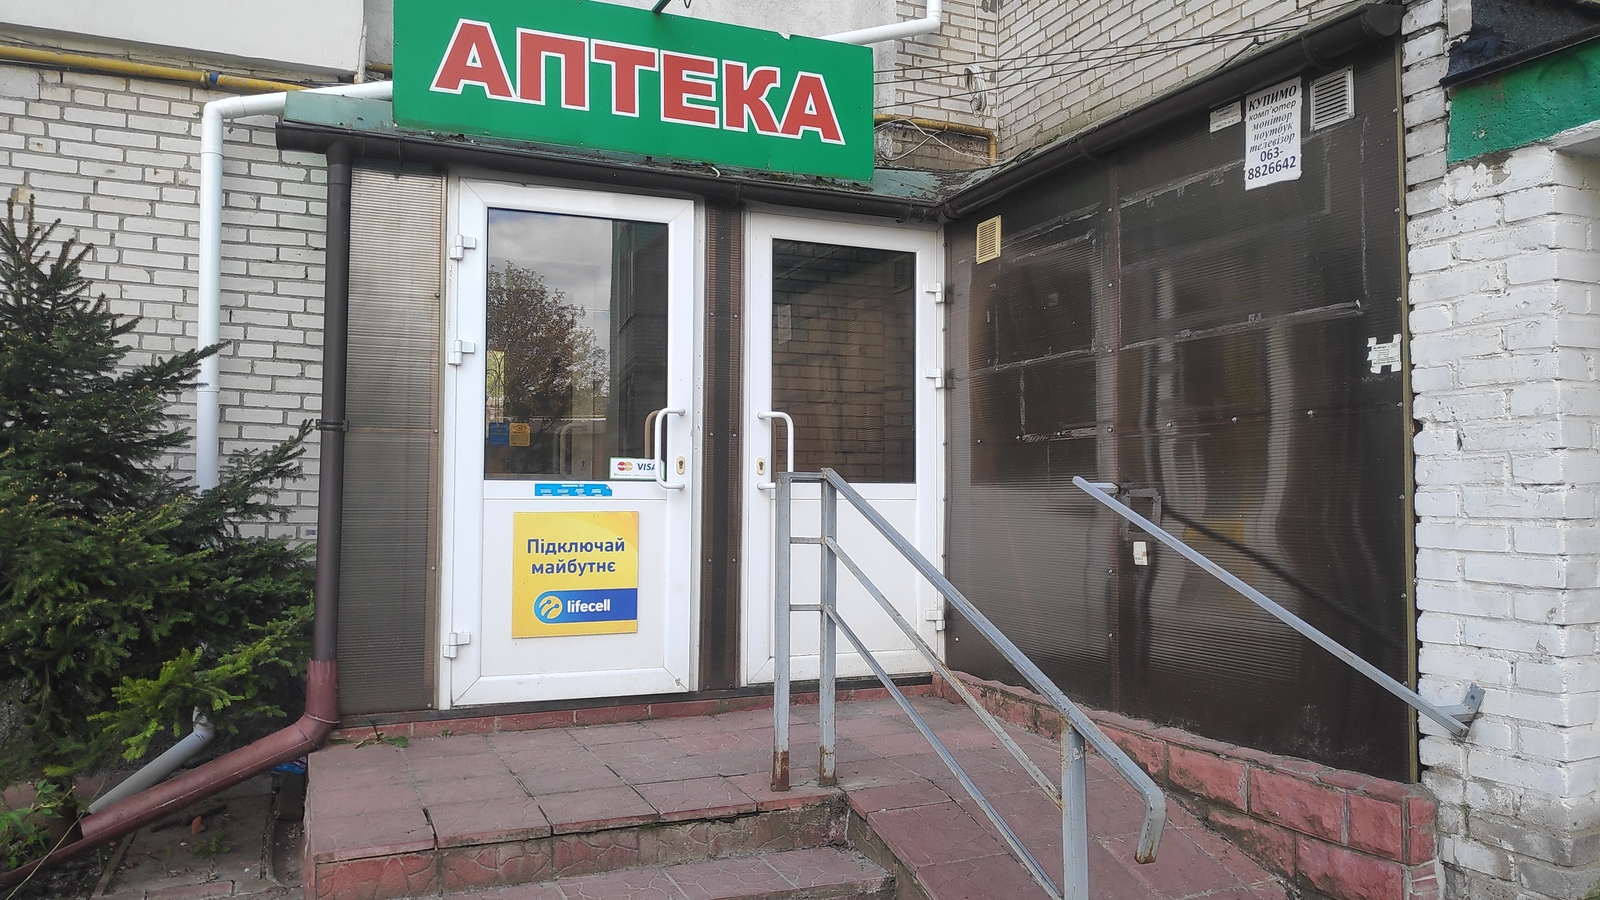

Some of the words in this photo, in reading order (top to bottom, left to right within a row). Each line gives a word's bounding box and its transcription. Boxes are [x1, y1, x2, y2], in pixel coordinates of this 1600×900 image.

[429, 18, 846, 146] АПТЕКА
[1248, 85, 1297, 112] КУПИМО
[1248, 99, 1297, 122] комп'ютер
[1251, 112, 1293, 131] монітор
[1253, 122, 1294, 141] ноутбук
[1249, 132, 1295, 153] телевізор
[1260, 146, 1284, 162] 063-
[1247, 155, 1297, 180] 8826642
[527, 537, 625, 555] Підключай
[531, 558, 616, 577] майбутнє
[567, 599, 611, 613] lifecell
